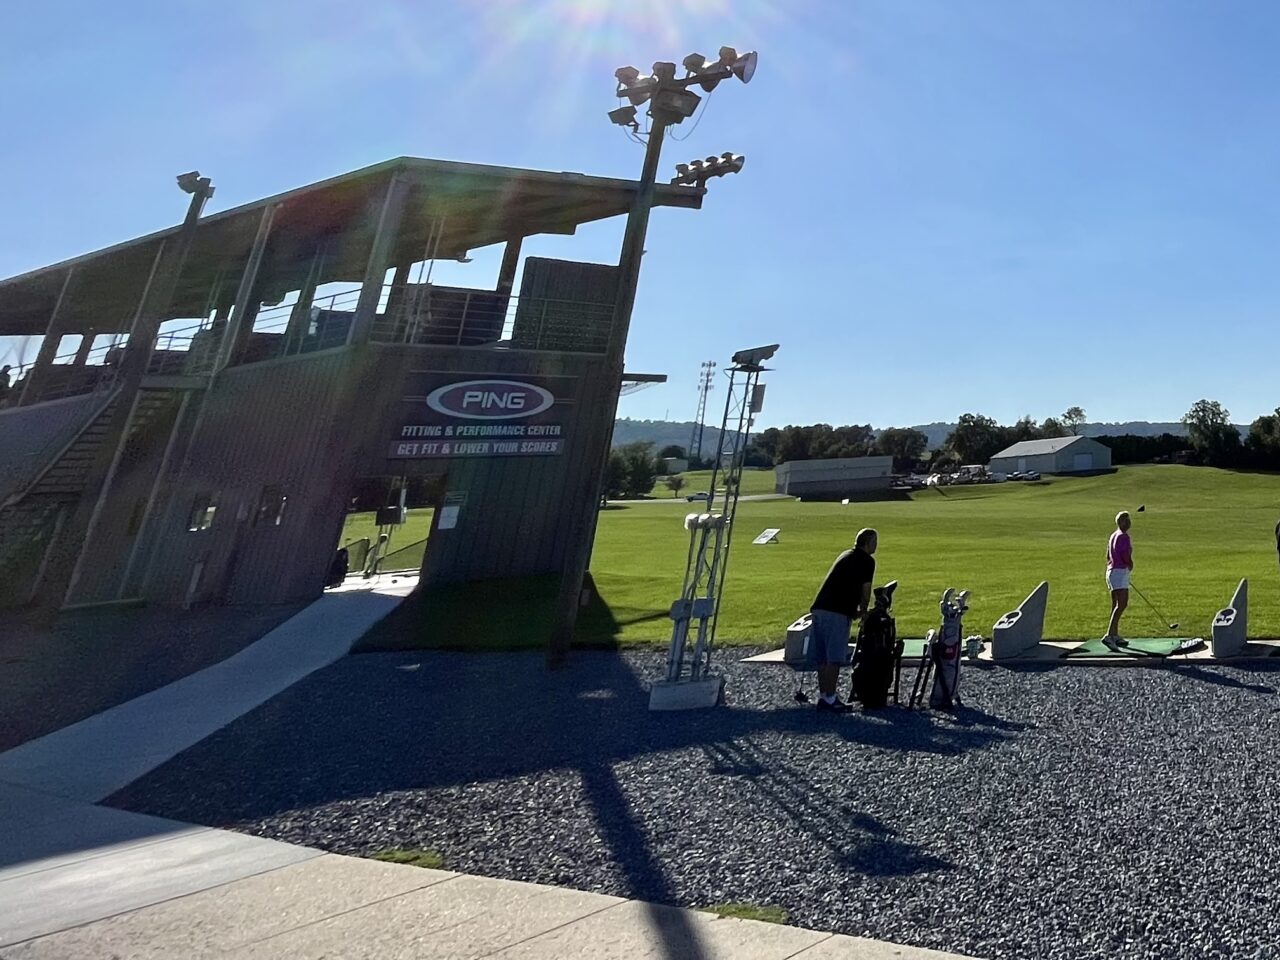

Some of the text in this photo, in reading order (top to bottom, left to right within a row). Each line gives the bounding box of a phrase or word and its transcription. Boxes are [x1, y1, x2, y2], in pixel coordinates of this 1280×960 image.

[463, 391, 526, 409] PING
[401, 425, 561, 436] FITTING & PERFORMANCE CENTER
[397, 441, 558, 455] GET FIT & LOWER YOUR SCORES
